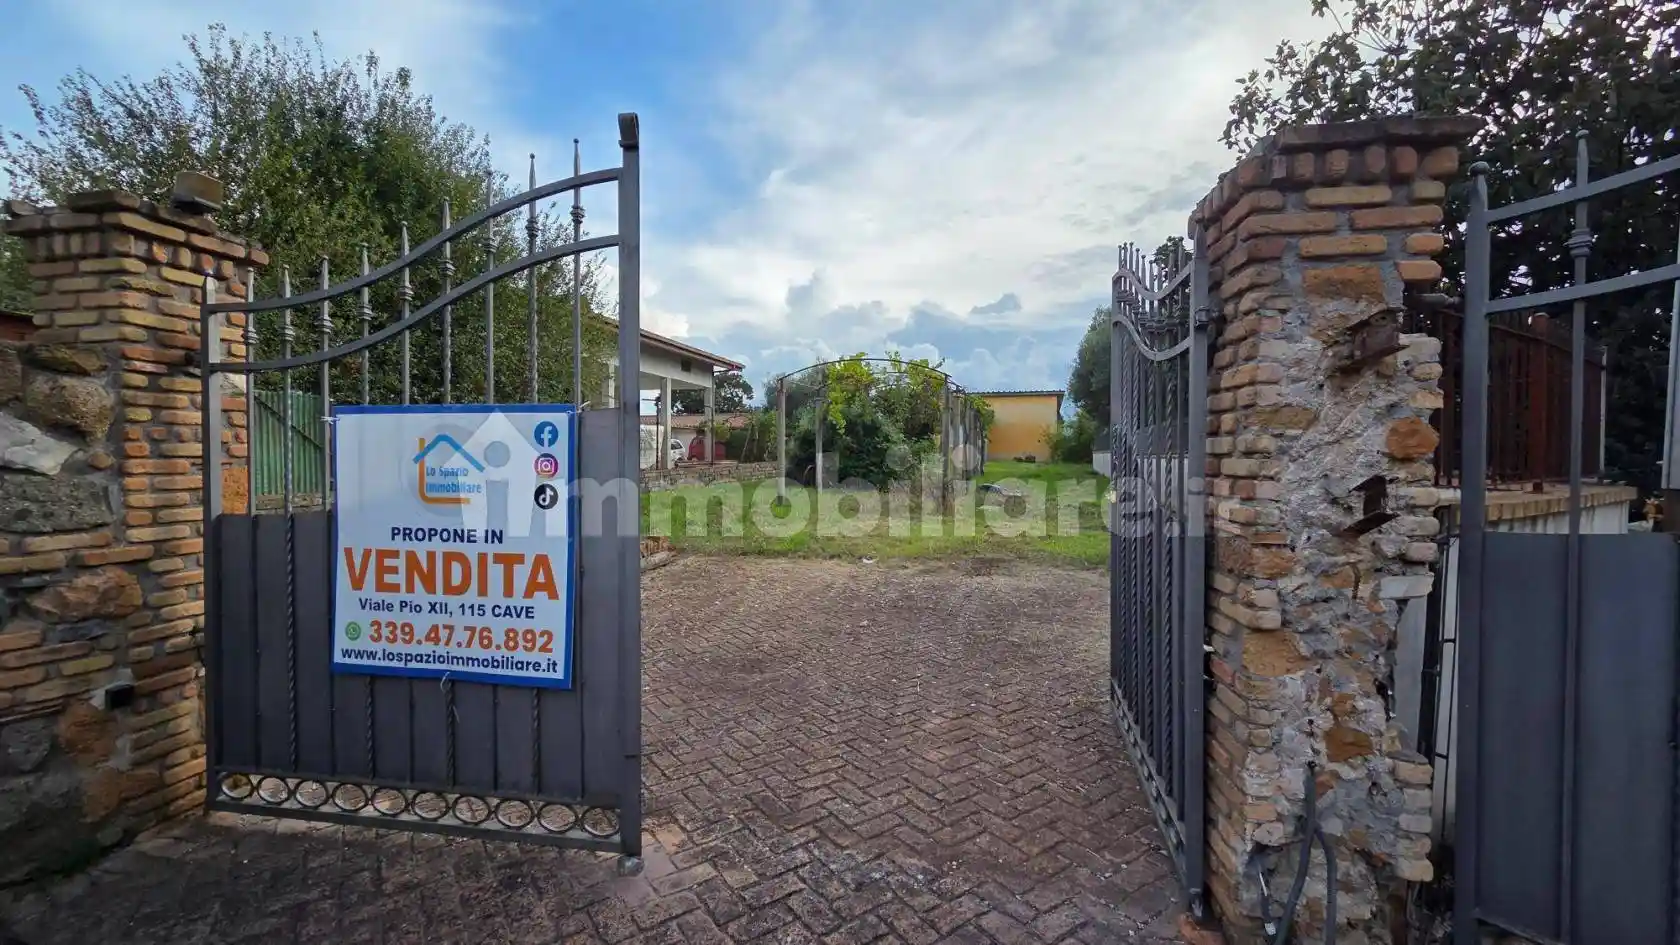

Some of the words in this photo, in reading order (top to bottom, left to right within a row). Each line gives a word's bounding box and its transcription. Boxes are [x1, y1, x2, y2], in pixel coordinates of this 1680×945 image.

[426, 466, 436, 477] Lo
[439, 466, 469, 480] Spazio
[426, 482, 482, 494] Immobiliare
[391, 526, 477, 544] PROPONE
[484, 529, 504, 544] IN
[344, 547, 560, 601] VENDITA
[359, 598, 394, 613] Viale
[399, 600, 423, 614] Pio
[428, 601, 453, 618] XII,
[458, 603, 486, 617] 115
[491, 604, 535, 619] CAVE
[369, 619, 554, 654] 339.47.76.892
[341, 647, 558, 674] www.lospazioimmobiliare.it
